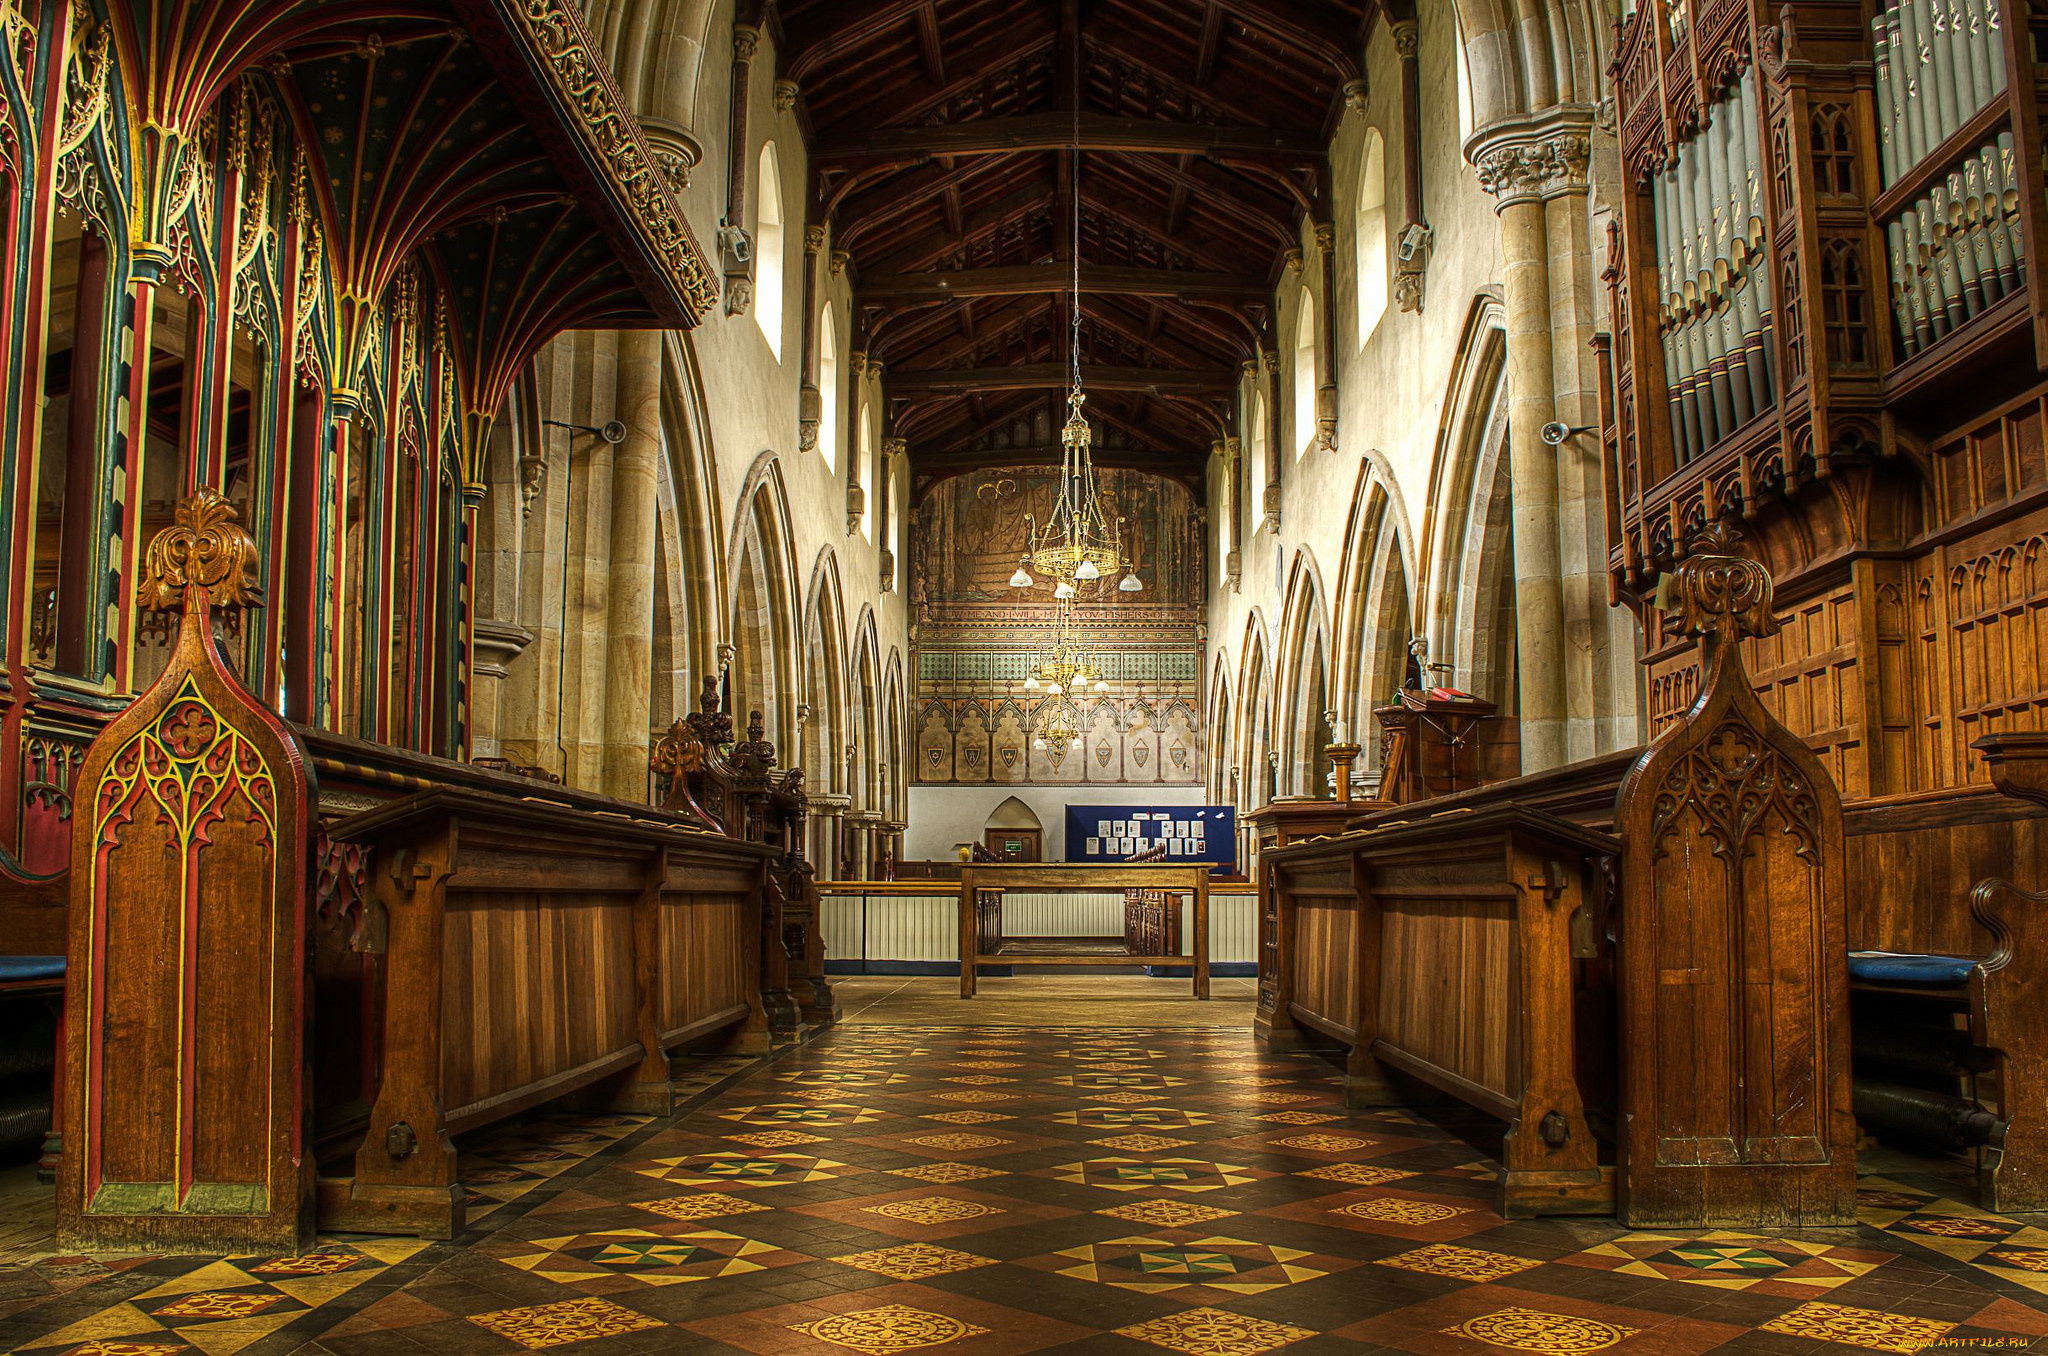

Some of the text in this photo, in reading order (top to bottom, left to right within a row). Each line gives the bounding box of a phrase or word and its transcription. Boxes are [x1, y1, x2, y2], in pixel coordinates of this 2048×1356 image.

[967, 610, 982, 618] ME
[984, 610, 1006, 618] AND
[1015, 610, 1040, 618] WILL
[1105, 611, 1149, 619] FISHERS
[1151, 611, 1166, 619] OF
